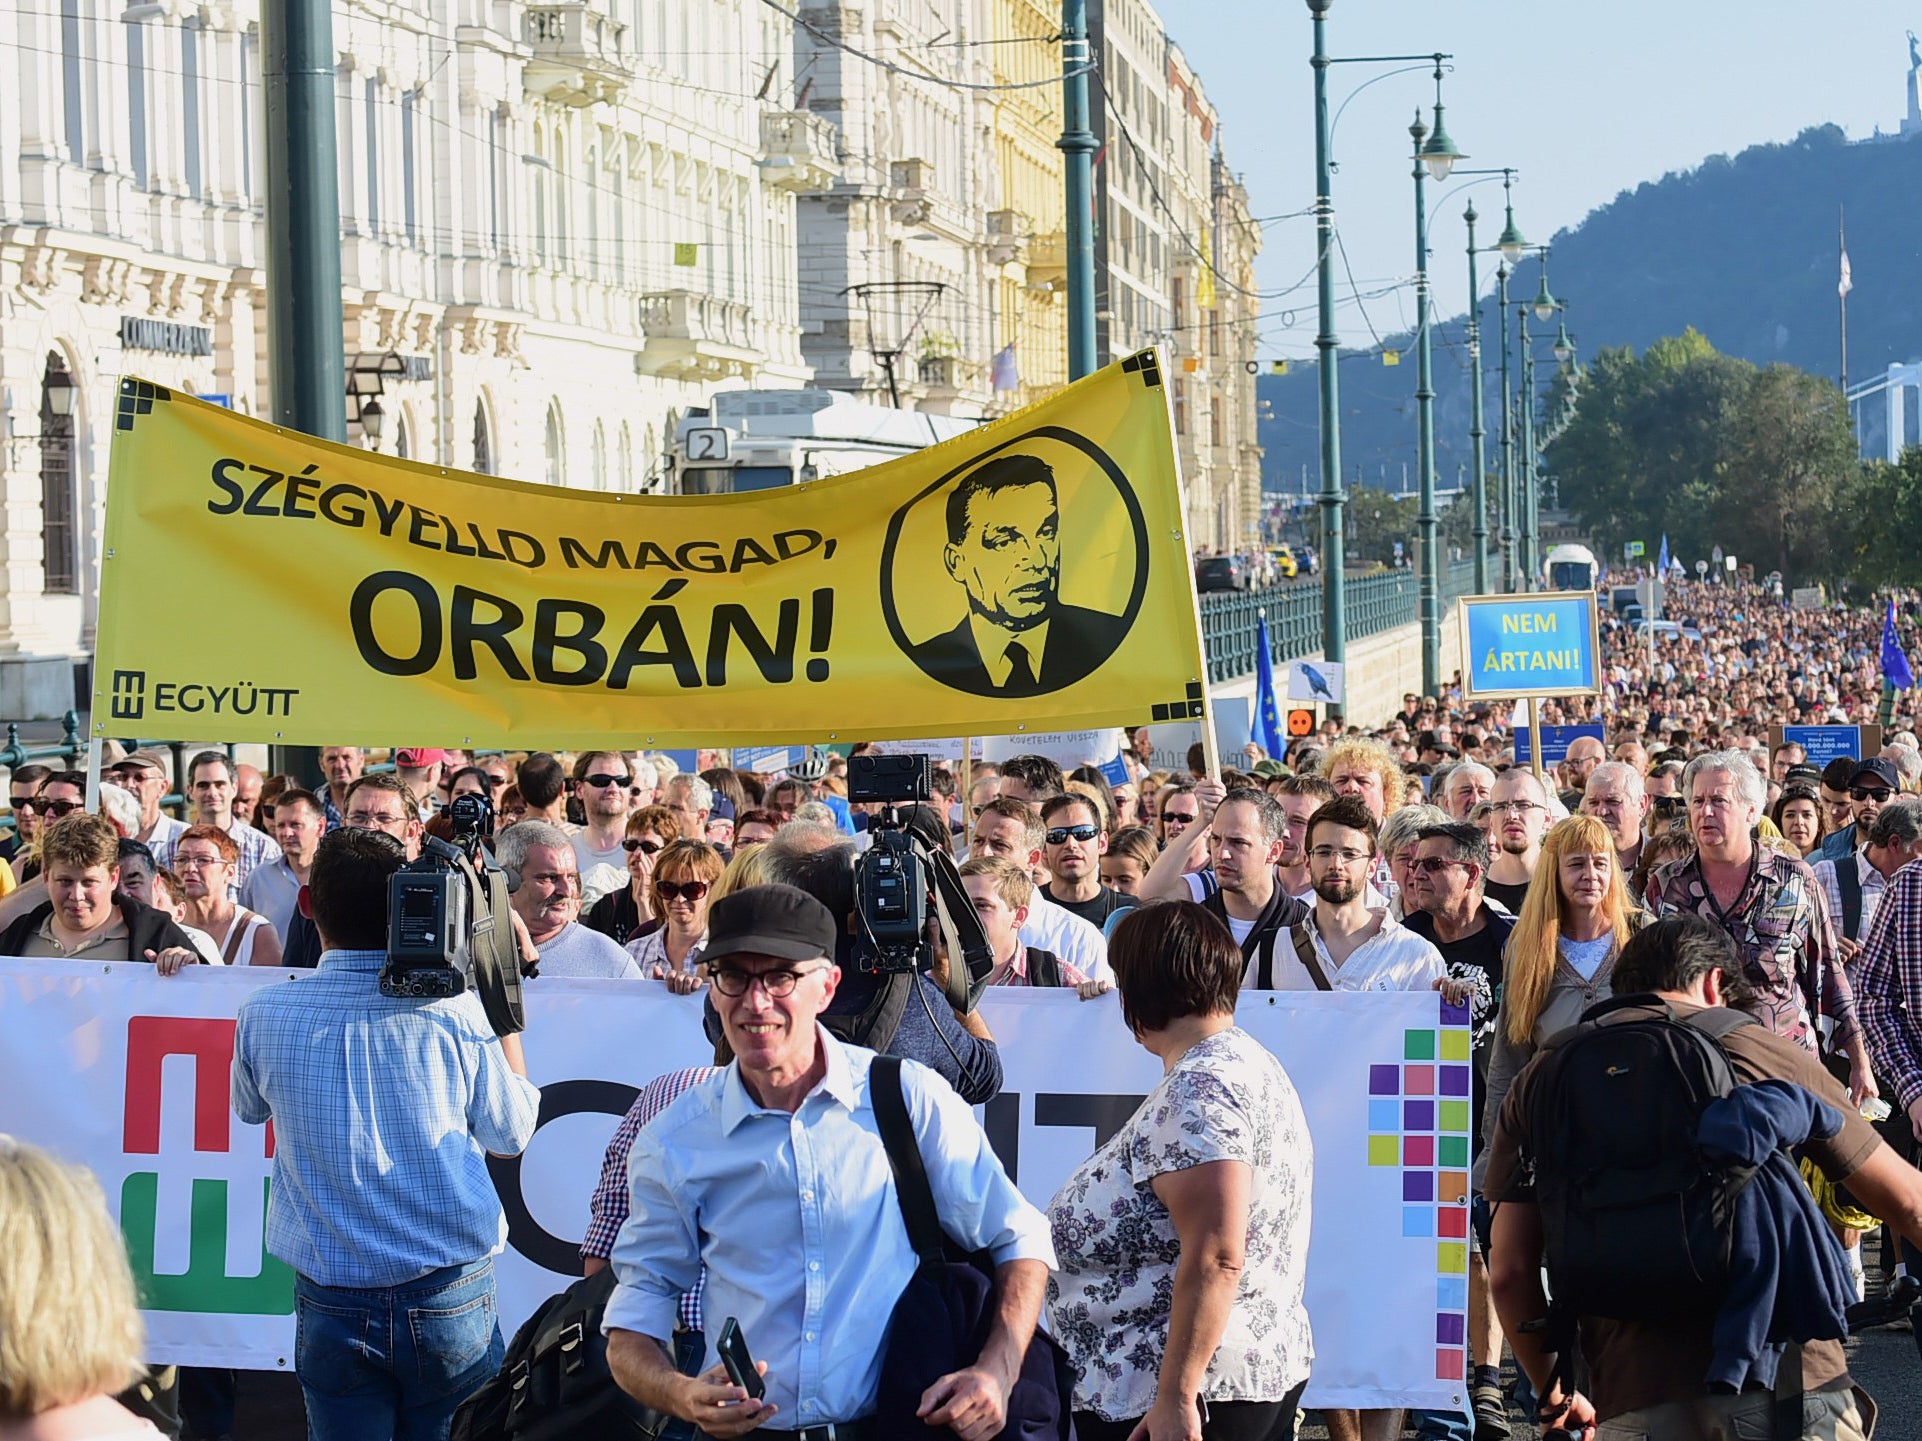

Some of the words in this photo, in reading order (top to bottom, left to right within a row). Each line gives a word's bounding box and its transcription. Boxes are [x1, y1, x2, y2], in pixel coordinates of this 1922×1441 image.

[699, 434, 715, 460] 2
[207, 458, 547, 569] SZÉGYELLD
[558, 529, 838, 574] MAGAD,
[350, 570, 834, 690] ORBÁN!
[1502, 612, 1558, 634] NEM
[1483, 647, 1580, 673] ÁRTANI!
[155, 681, 300, 717] EGYÜTT
